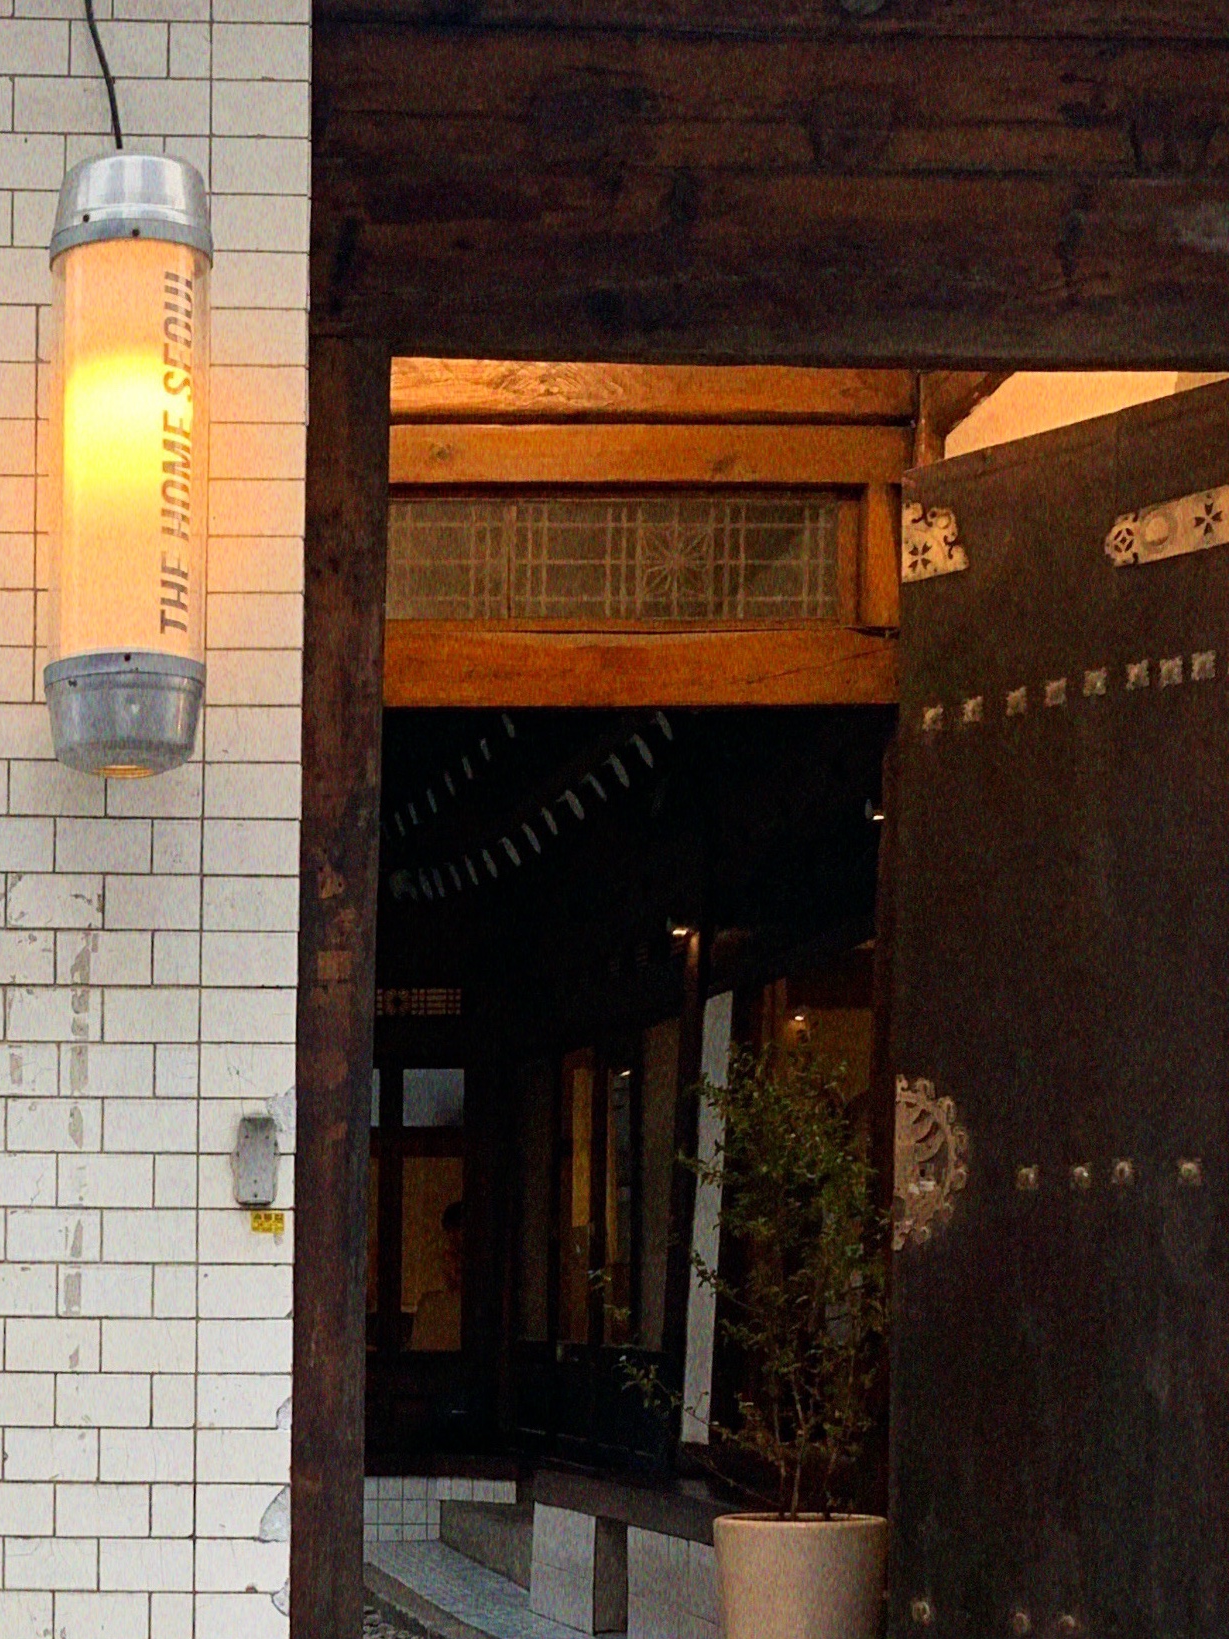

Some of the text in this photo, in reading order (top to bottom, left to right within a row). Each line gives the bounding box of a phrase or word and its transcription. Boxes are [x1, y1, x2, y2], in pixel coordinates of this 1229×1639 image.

[160, 271, 194, 635] THE HOME SEOUL
